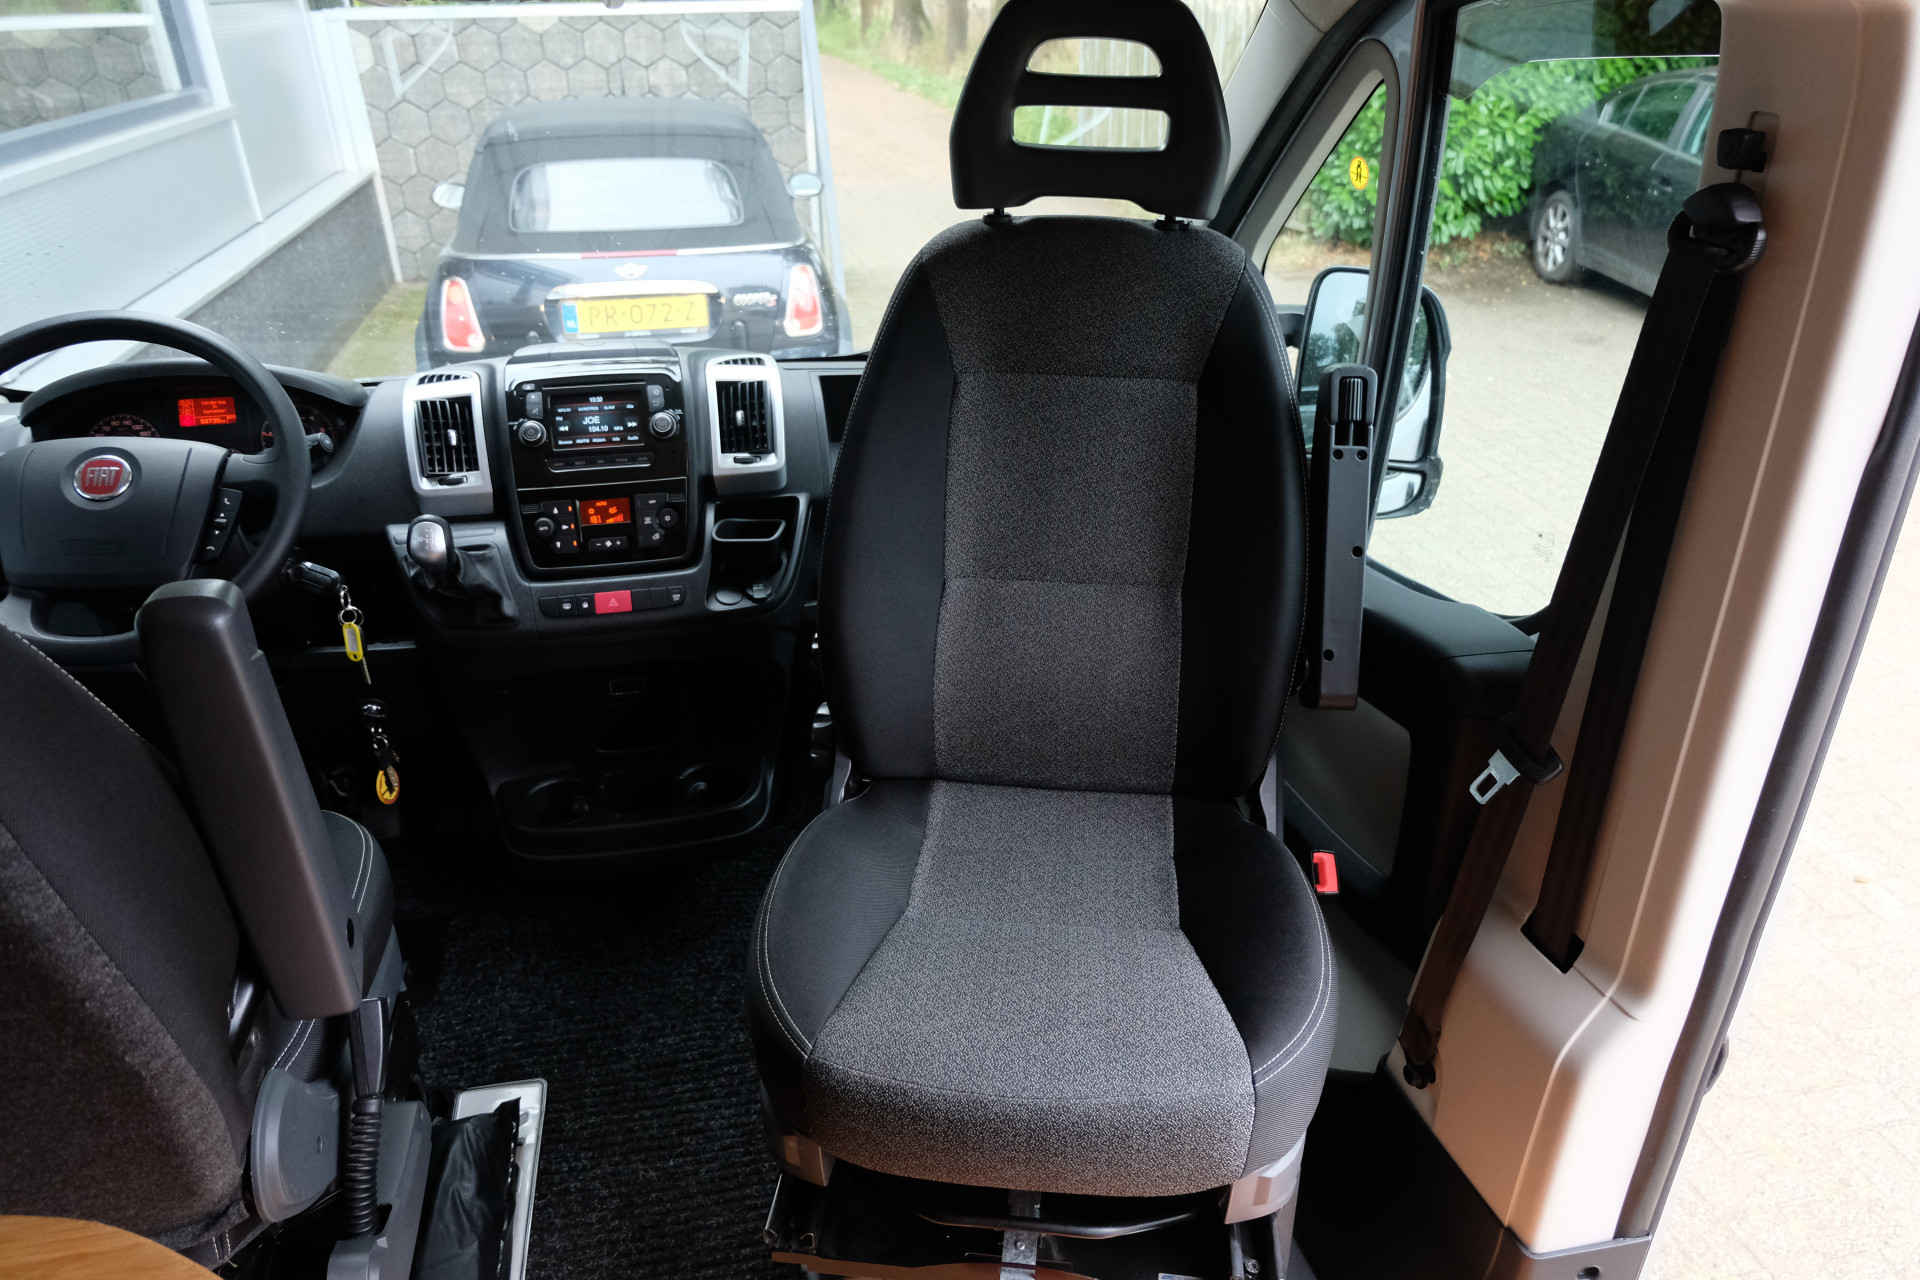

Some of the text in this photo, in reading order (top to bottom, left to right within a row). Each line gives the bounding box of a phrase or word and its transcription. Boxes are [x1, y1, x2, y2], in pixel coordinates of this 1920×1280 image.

[588, 301, 696, 326] PR-072-Z
[582, 416, 600, 425] JOE
[85, 466, 121, 487] FIAT
